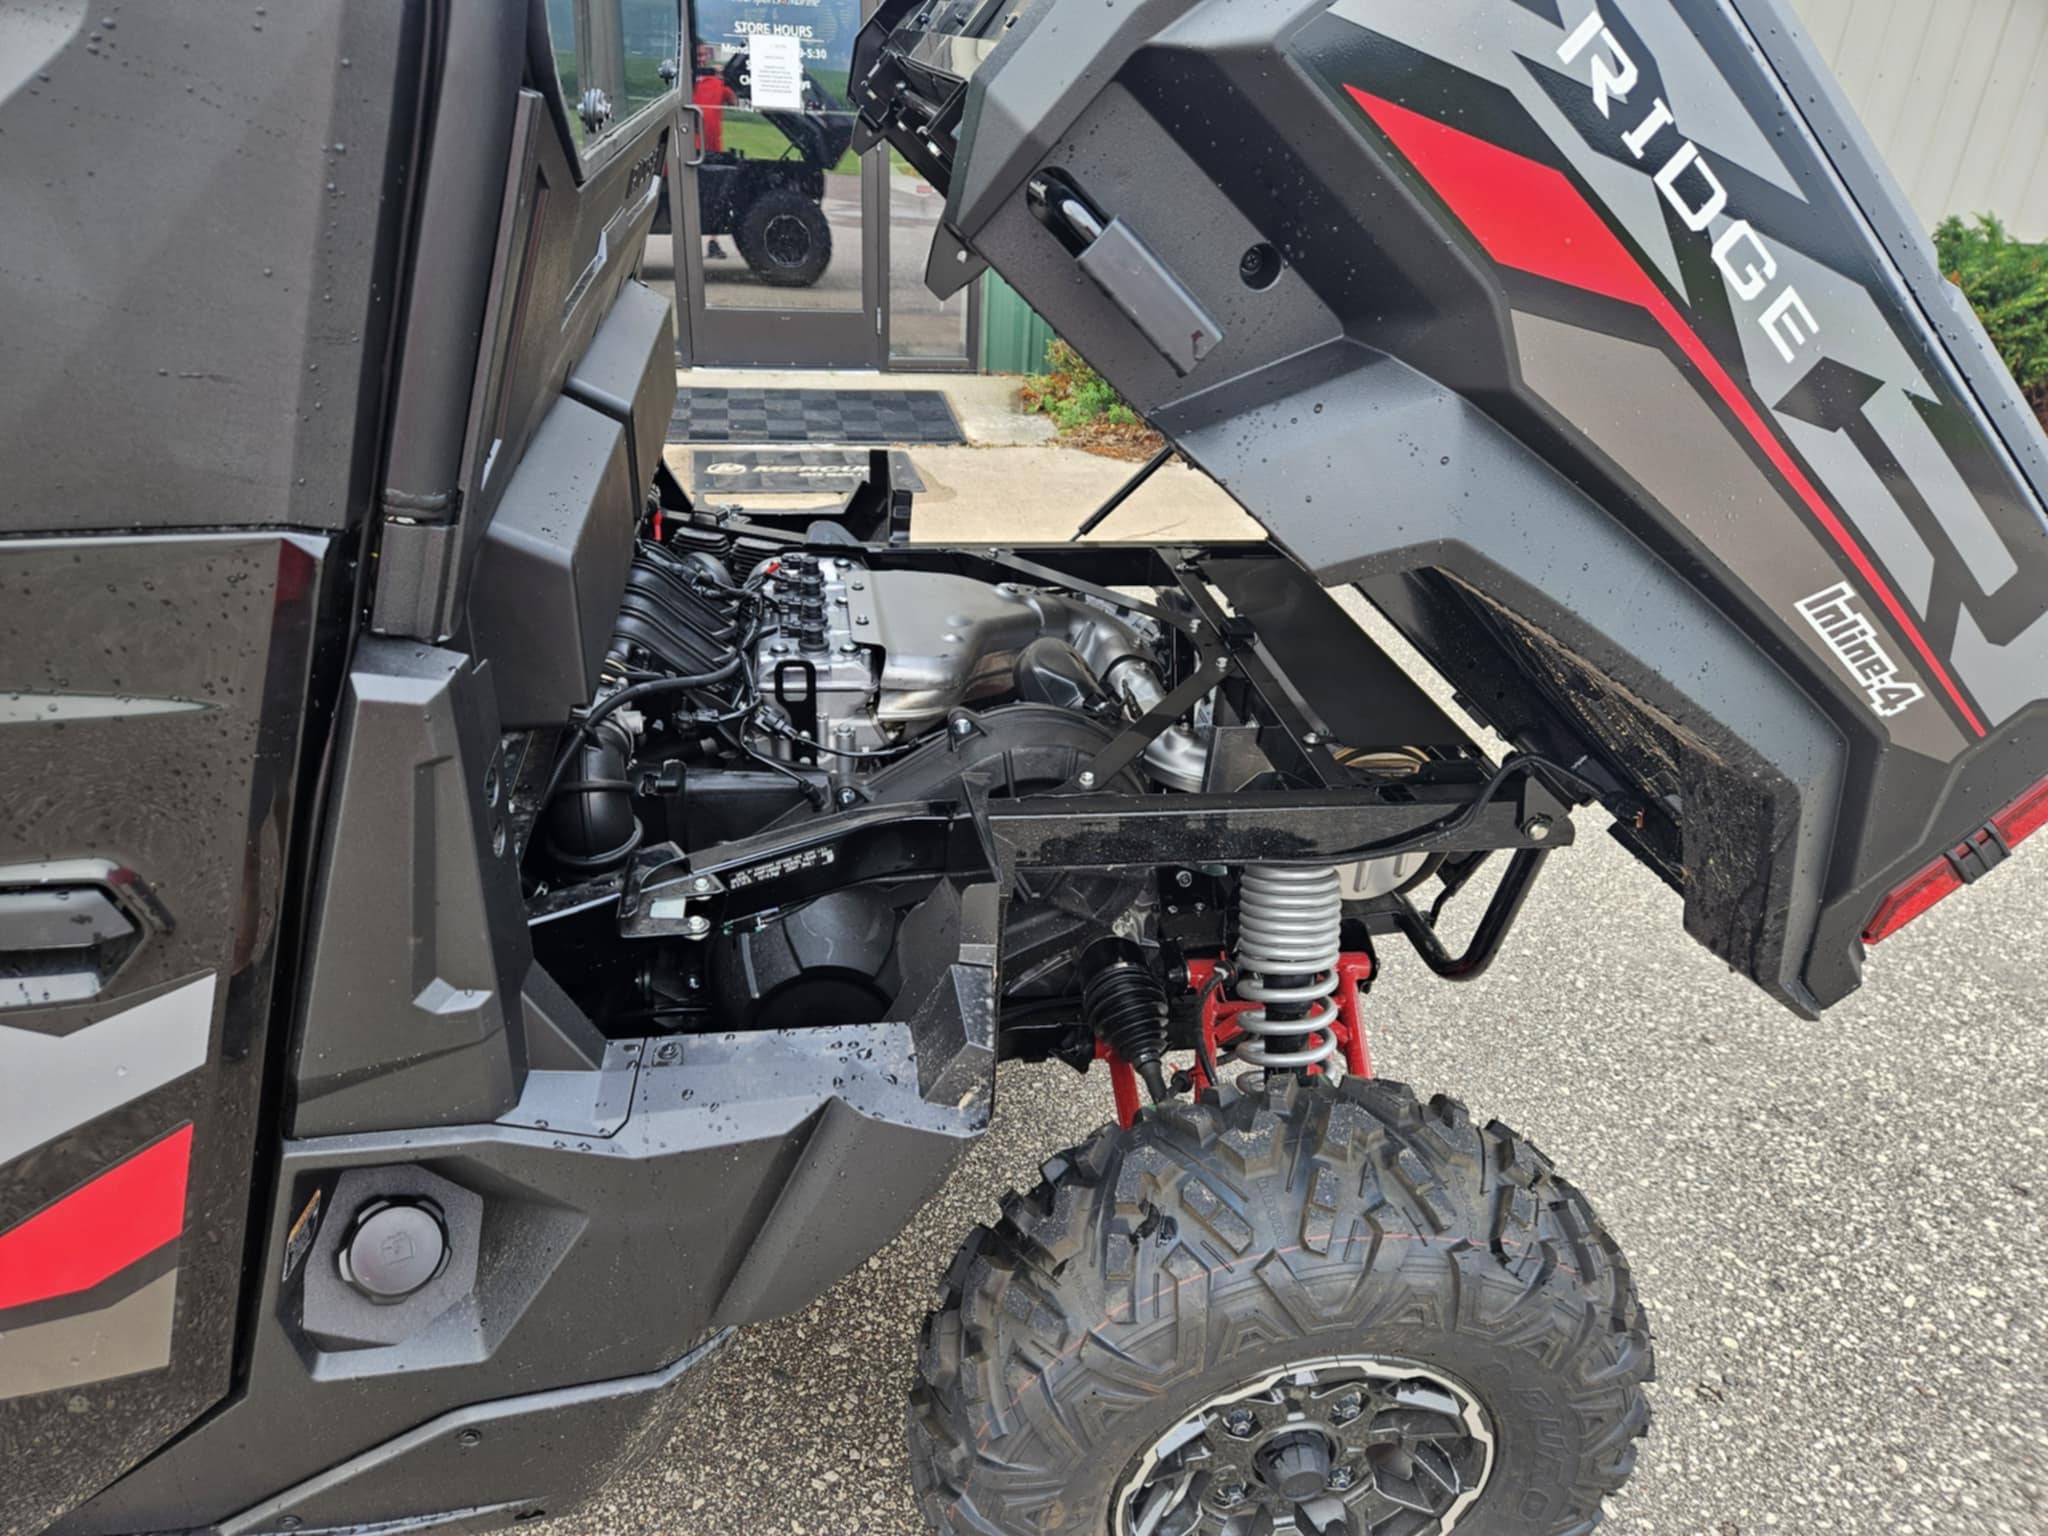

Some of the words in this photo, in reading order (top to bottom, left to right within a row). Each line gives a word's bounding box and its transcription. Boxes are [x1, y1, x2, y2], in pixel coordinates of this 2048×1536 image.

[734, 20, 771, 35] STORE
[773, 23, 813, 38] HOURS
[1556, 8, 1819, 365] RIDGE
[1793, 580, 1925, 717] Inline-4
